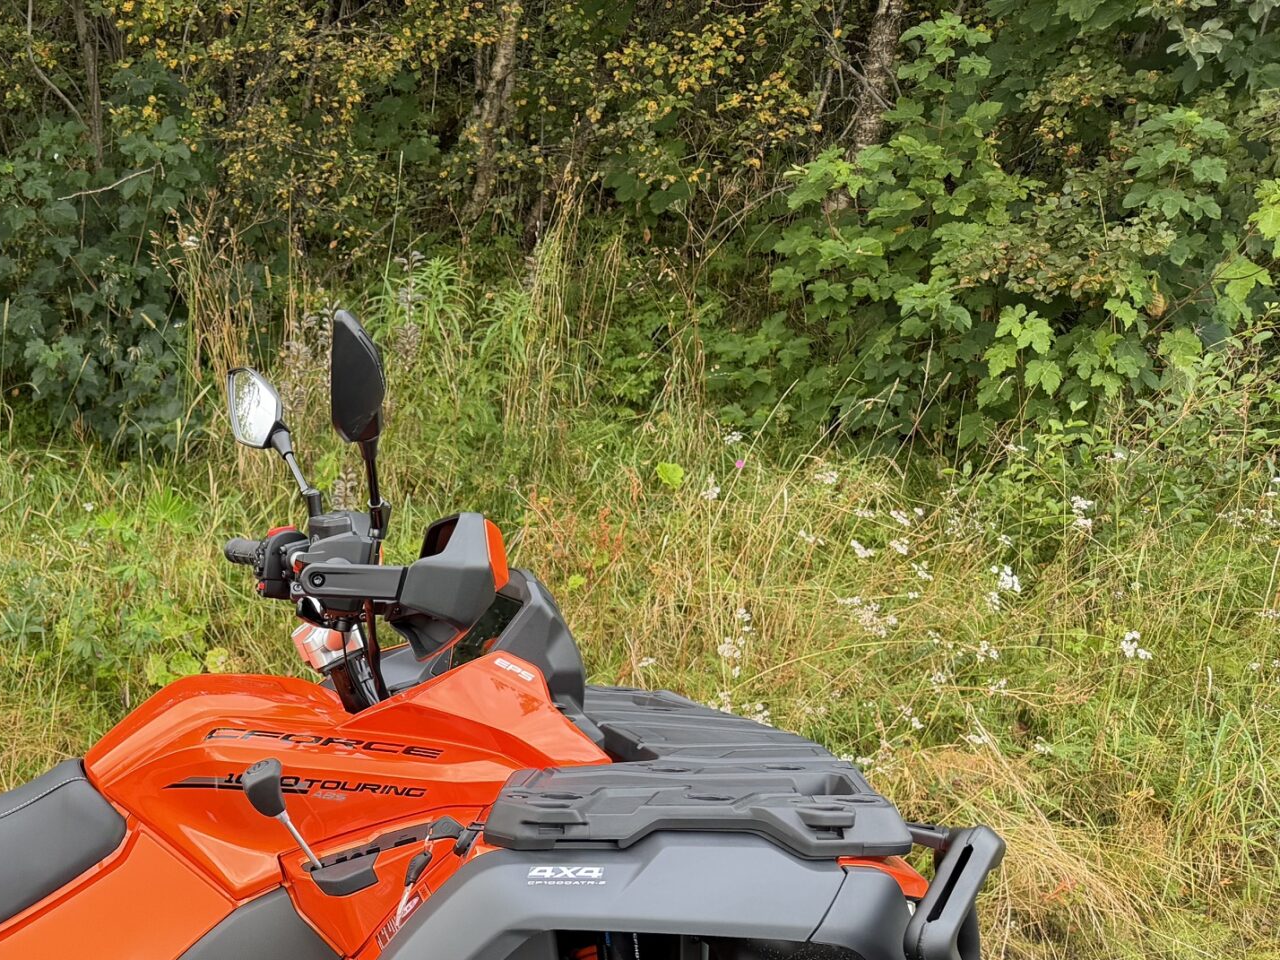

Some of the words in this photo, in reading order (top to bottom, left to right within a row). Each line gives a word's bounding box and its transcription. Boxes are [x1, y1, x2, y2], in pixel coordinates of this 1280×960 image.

[494, 657, 535, 682] EPS
[204, 727, 444, 759] CFORCE
[224, 772, 300, 787] 10
[307, 779, 427, 798] TOURING
